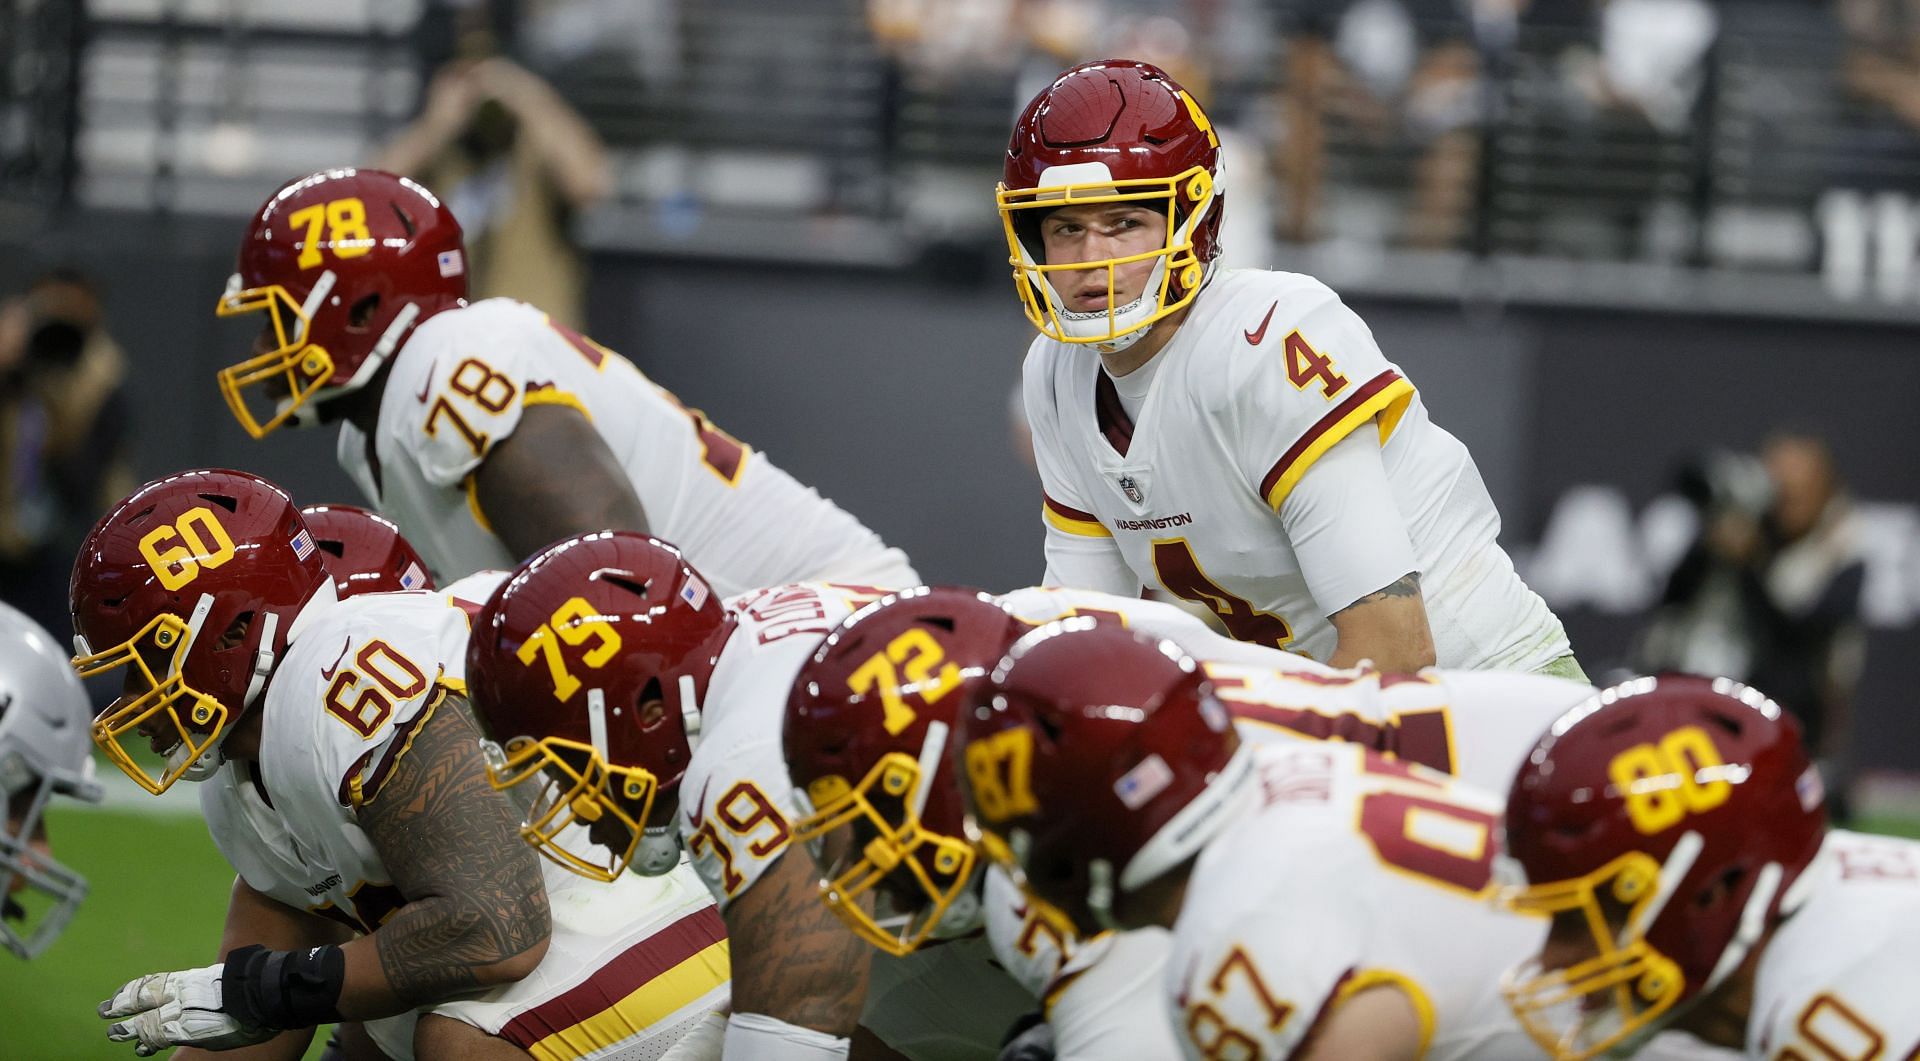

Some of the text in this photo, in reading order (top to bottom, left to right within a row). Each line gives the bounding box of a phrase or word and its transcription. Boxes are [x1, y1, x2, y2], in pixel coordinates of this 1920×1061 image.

[1178, 89, 1219, 148] 4
[288, 197, 370, 270] 78
[424, 357, 519, 457] 78
[1282, 328, 1351, 401] 4
[138, 506, 235, 592] 60
[1114, 512, 1192, 530] WASHINGTON
[1152, 536, 1313, 659] 4
[323, 637, 429, 739] 60
[516, 596, 622, 703] 79
[847, 628, 966, 736] 72
[965, 726, 1038, 823] 87
[1609, 725, 1733, 835] 80
[689, 778, 793, 898] 79
[1186, 945, 1297, 1061] 87
[1772, 994, 1886, 1061] 0
